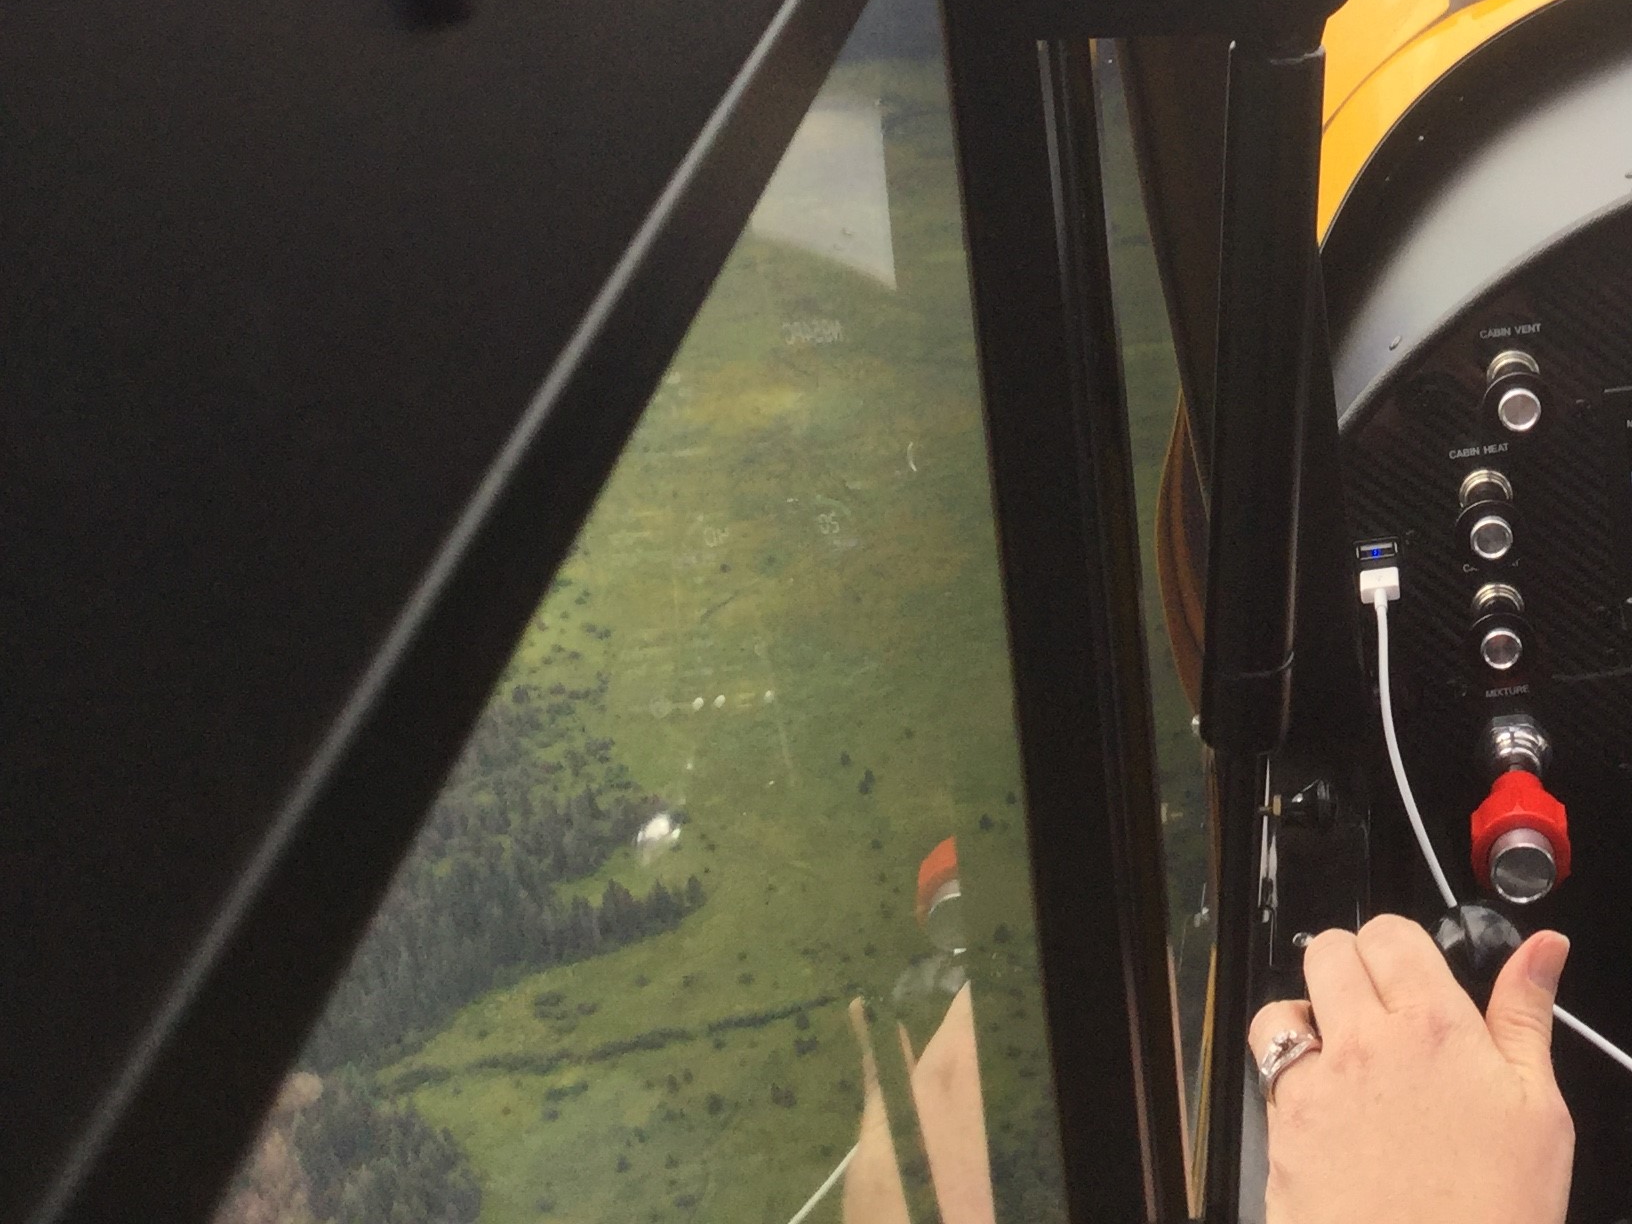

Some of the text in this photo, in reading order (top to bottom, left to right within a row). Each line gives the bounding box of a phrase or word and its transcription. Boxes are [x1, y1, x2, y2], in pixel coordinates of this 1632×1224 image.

[1480, 323, 1541, 339] CABIN VENT
[1449, 443, 1509, 459] CABIN HEAT
[1485, 684, 1529, 698] MIXTURE
